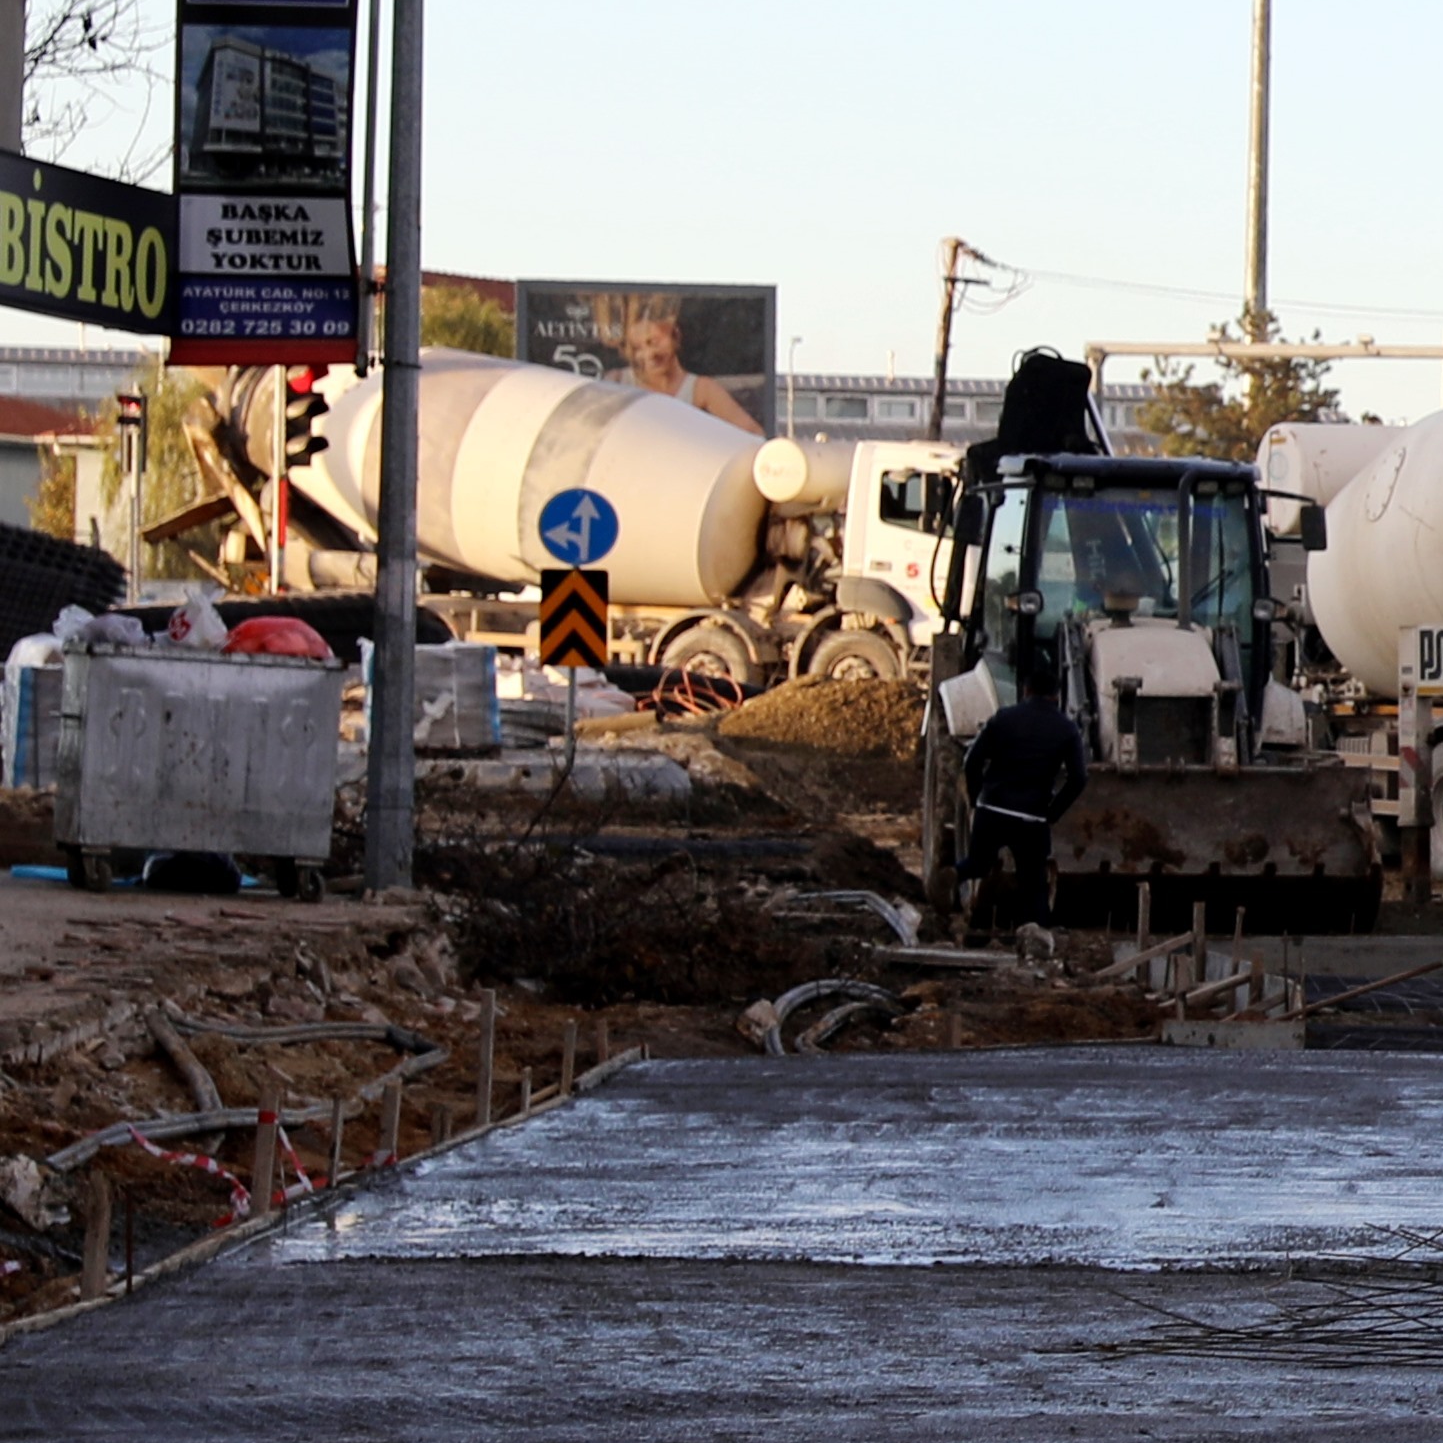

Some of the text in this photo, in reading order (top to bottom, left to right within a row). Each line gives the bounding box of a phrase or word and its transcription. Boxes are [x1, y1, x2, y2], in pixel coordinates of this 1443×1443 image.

[221, 204, 310, 222] BAŞKA
[0, 168, 167, 319] BİSTRO
[206, 228, 324, 247] ŞUBEMİZ
[211, 253, 322, 271] YOKTUR
[183, 286, 256, 298] ATATÜRK
[219, 301, 315, 314] ÇERKEZKÖY
[181, 320, 350, 335] 0282 725 30 09
